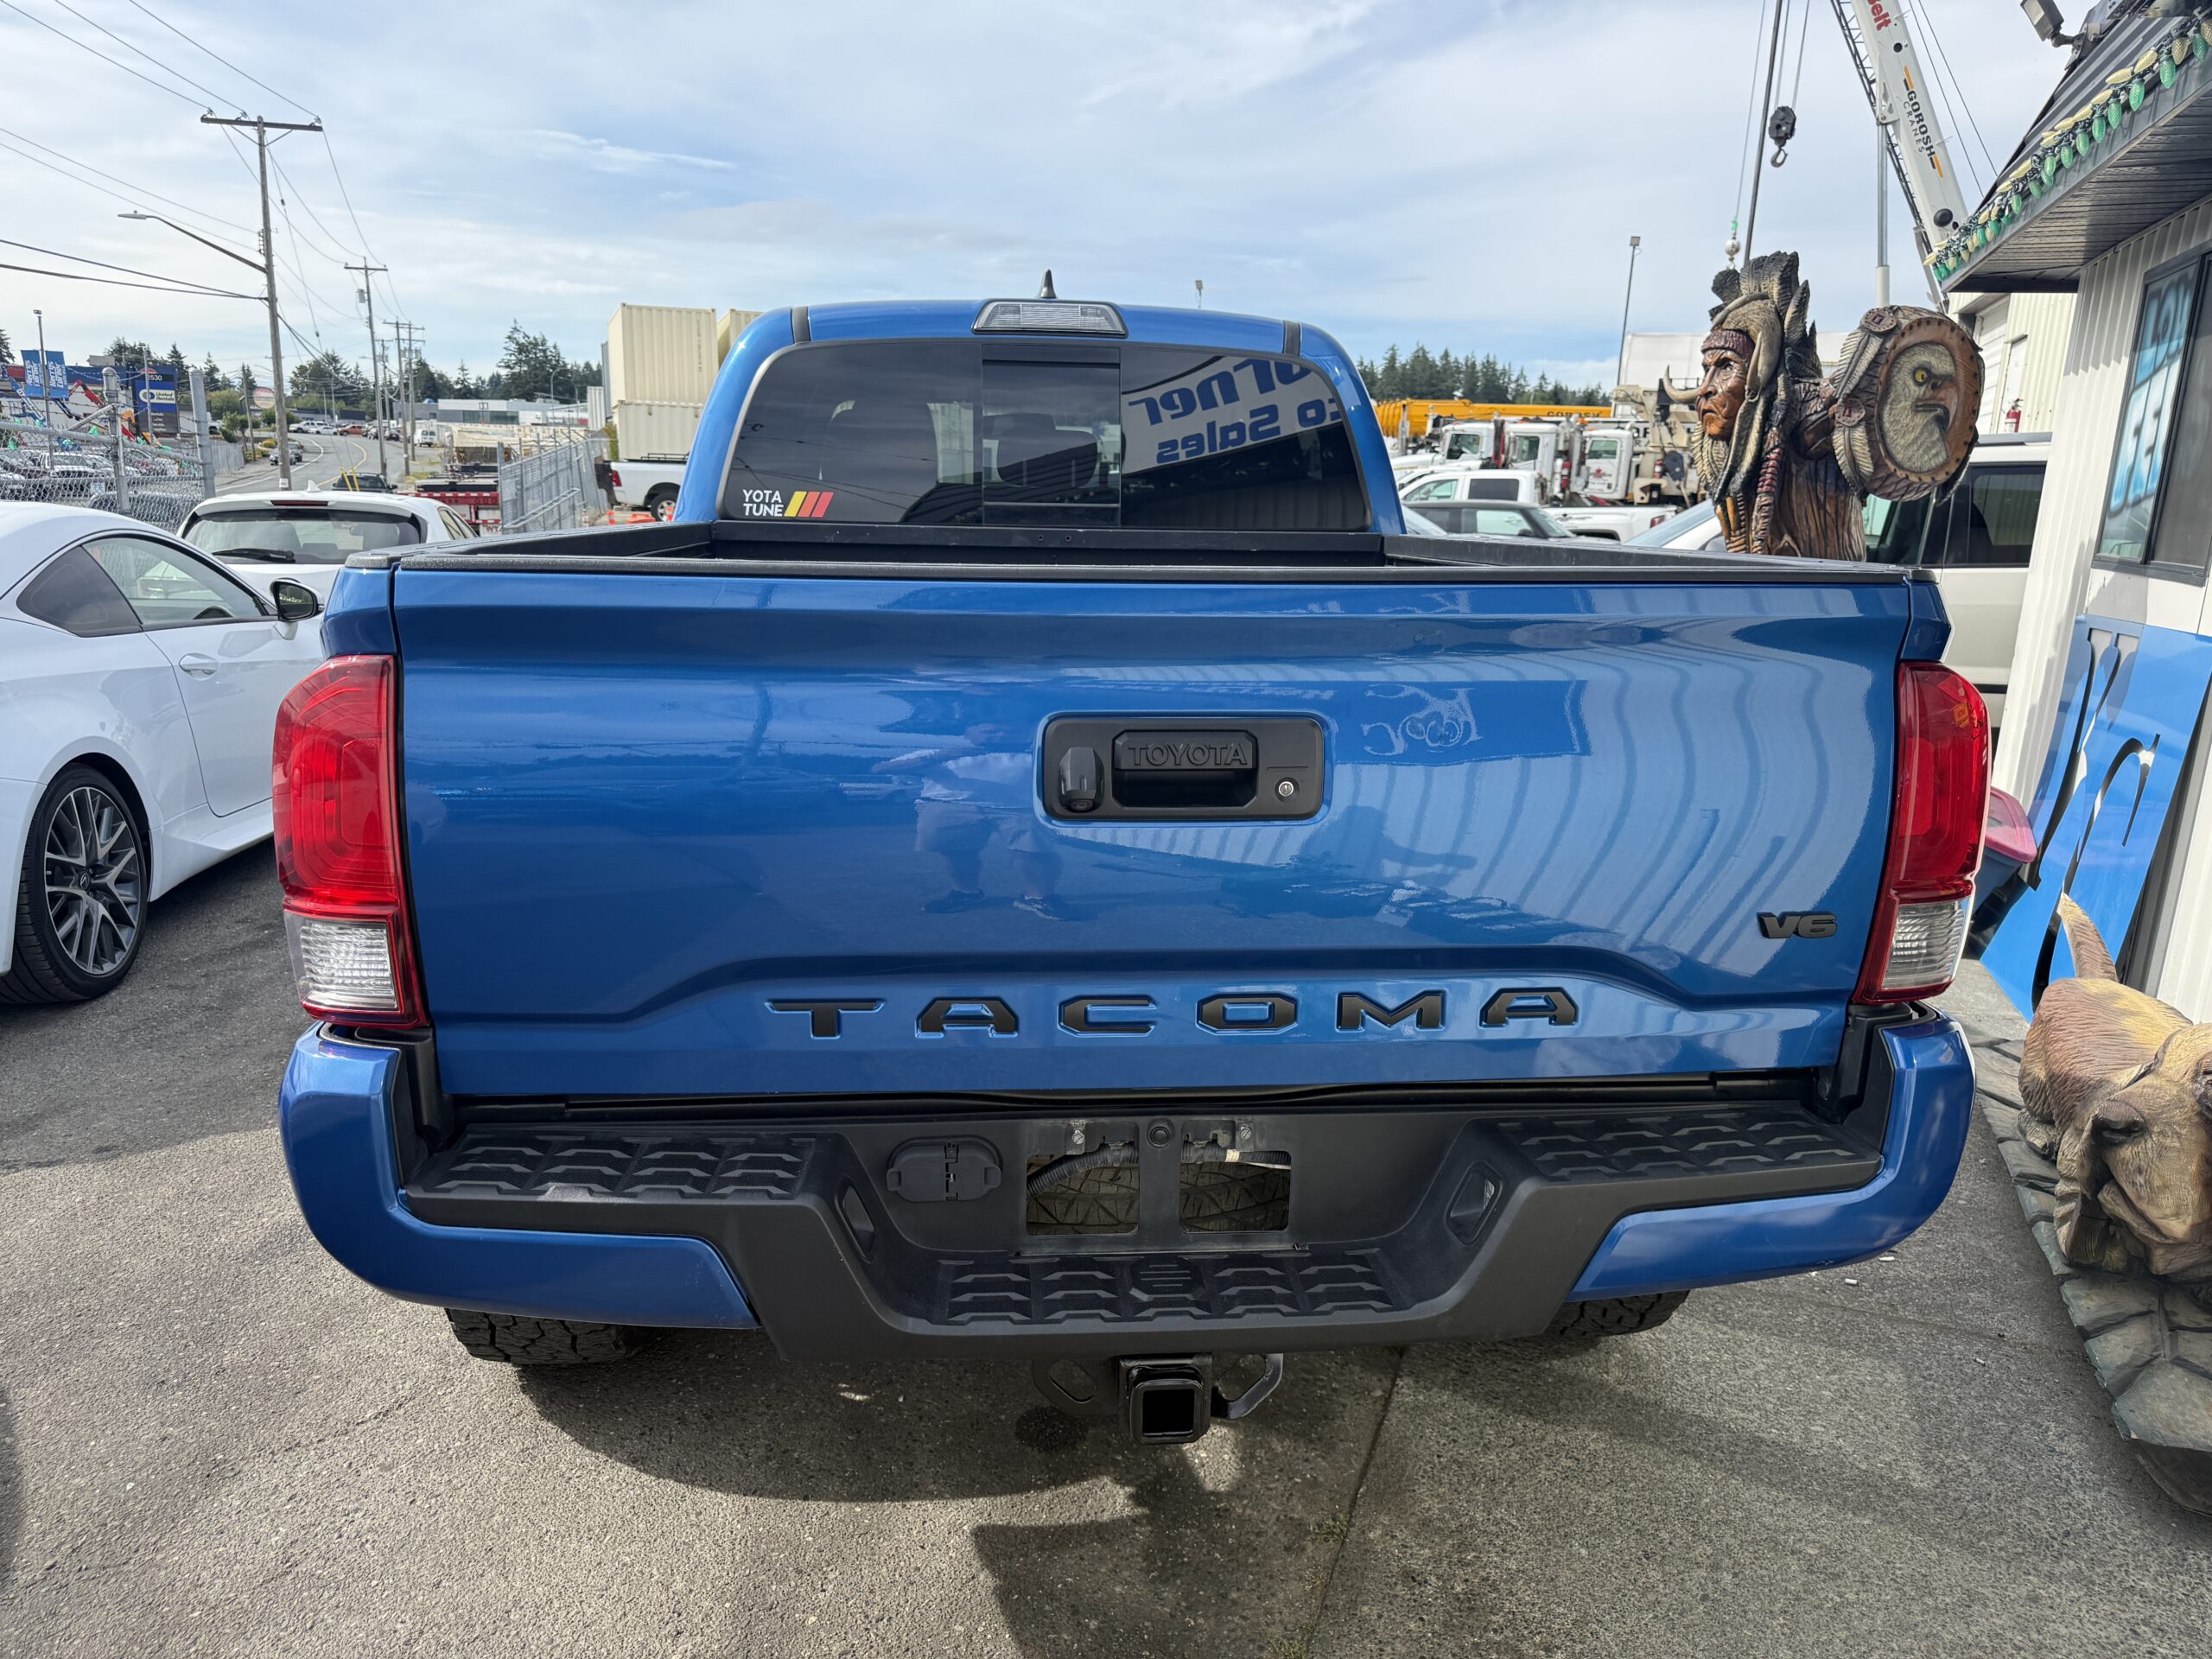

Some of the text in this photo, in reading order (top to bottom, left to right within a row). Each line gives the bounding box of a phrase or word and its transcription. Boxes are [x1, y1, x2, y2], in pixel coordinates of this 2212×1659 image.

[1867, 0, 1891, 31] elt
[1904, 101, 1925, 153] CRANES
[1907, 90, 1936, 158] GOROSH
[742, 489, 782, 503] YOTA
[743, 503, 784, 517] TUNE
[1128, 742, 1249, 766] TOYOTA
[1757, 912, 1838, 938] V6
[765, 987, 1580, 1040] TACOMA
